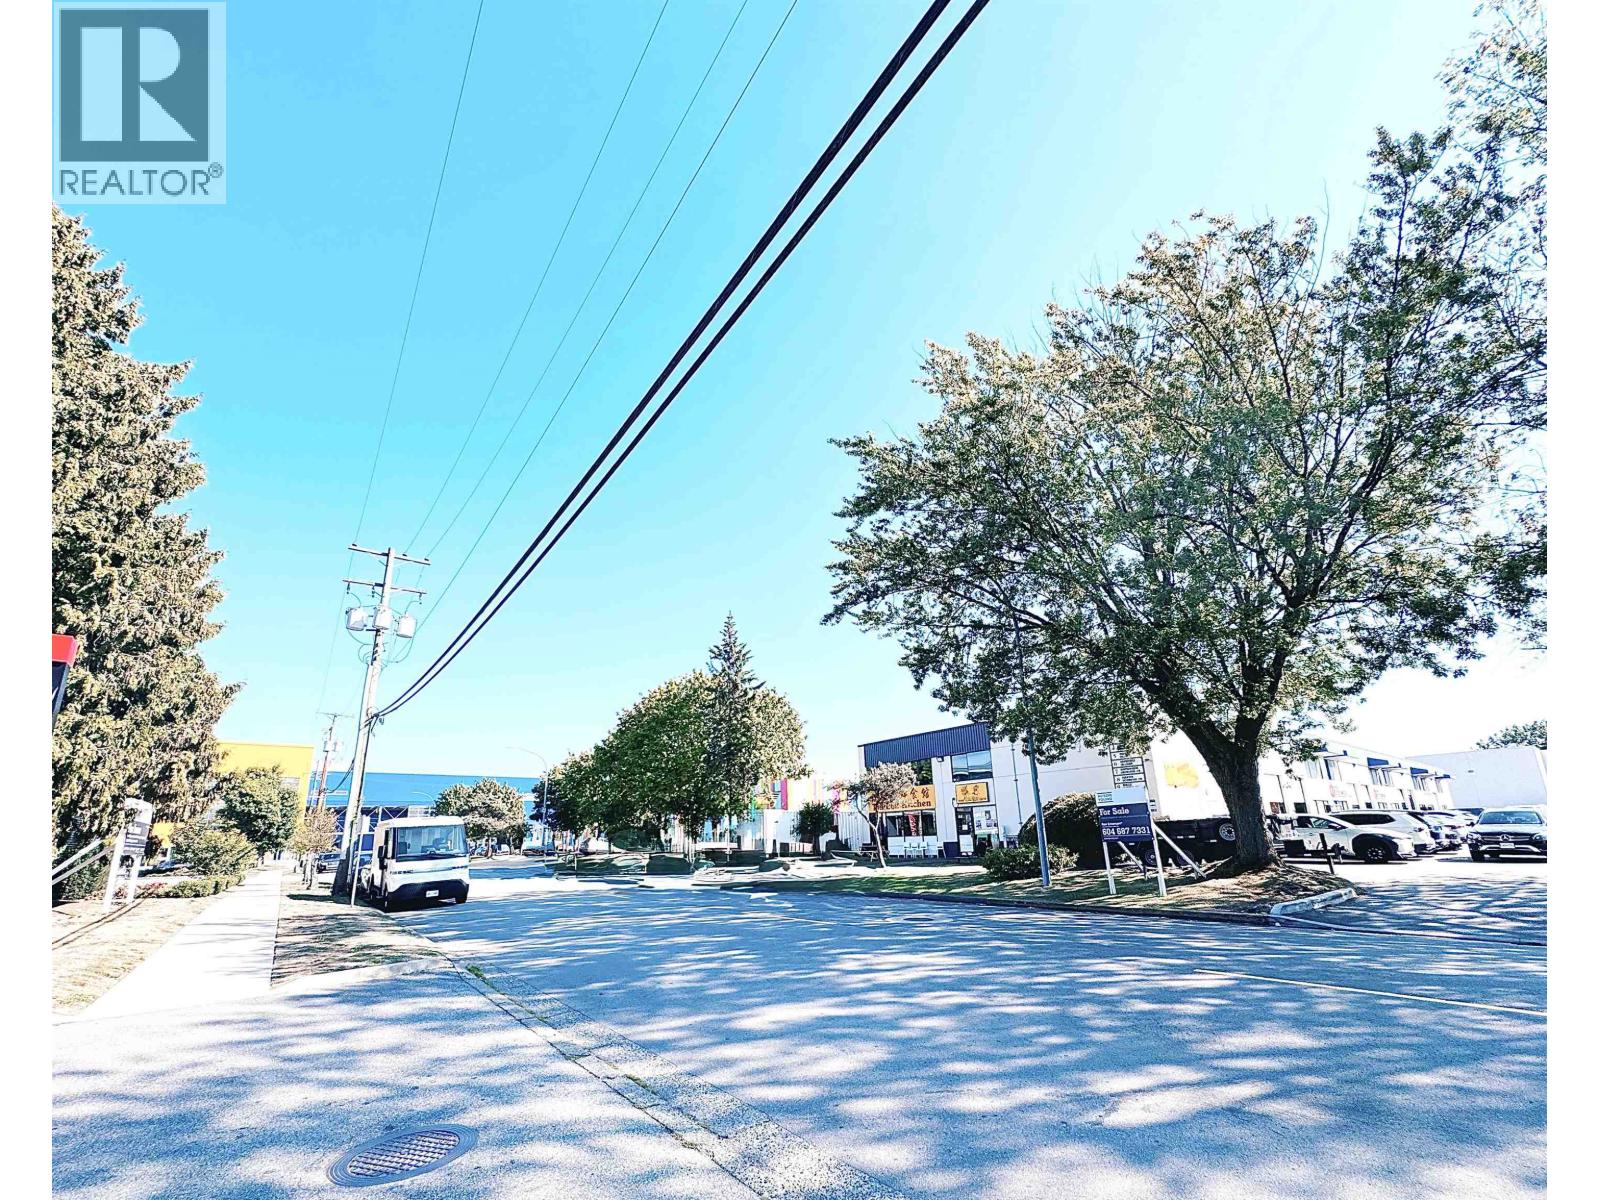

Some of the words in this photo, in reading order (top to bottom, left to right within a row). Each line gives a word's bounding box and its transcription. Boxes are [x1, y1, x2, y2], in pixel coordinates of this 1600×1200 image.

[1099, 808, 1111, 816] For
[1112, 806, 1130, 815] Sale
[1102, 828, 1116, 836] 604
[1117, 827, 1130, 835] 687
[1131, 826, 1151, 834] 7331
